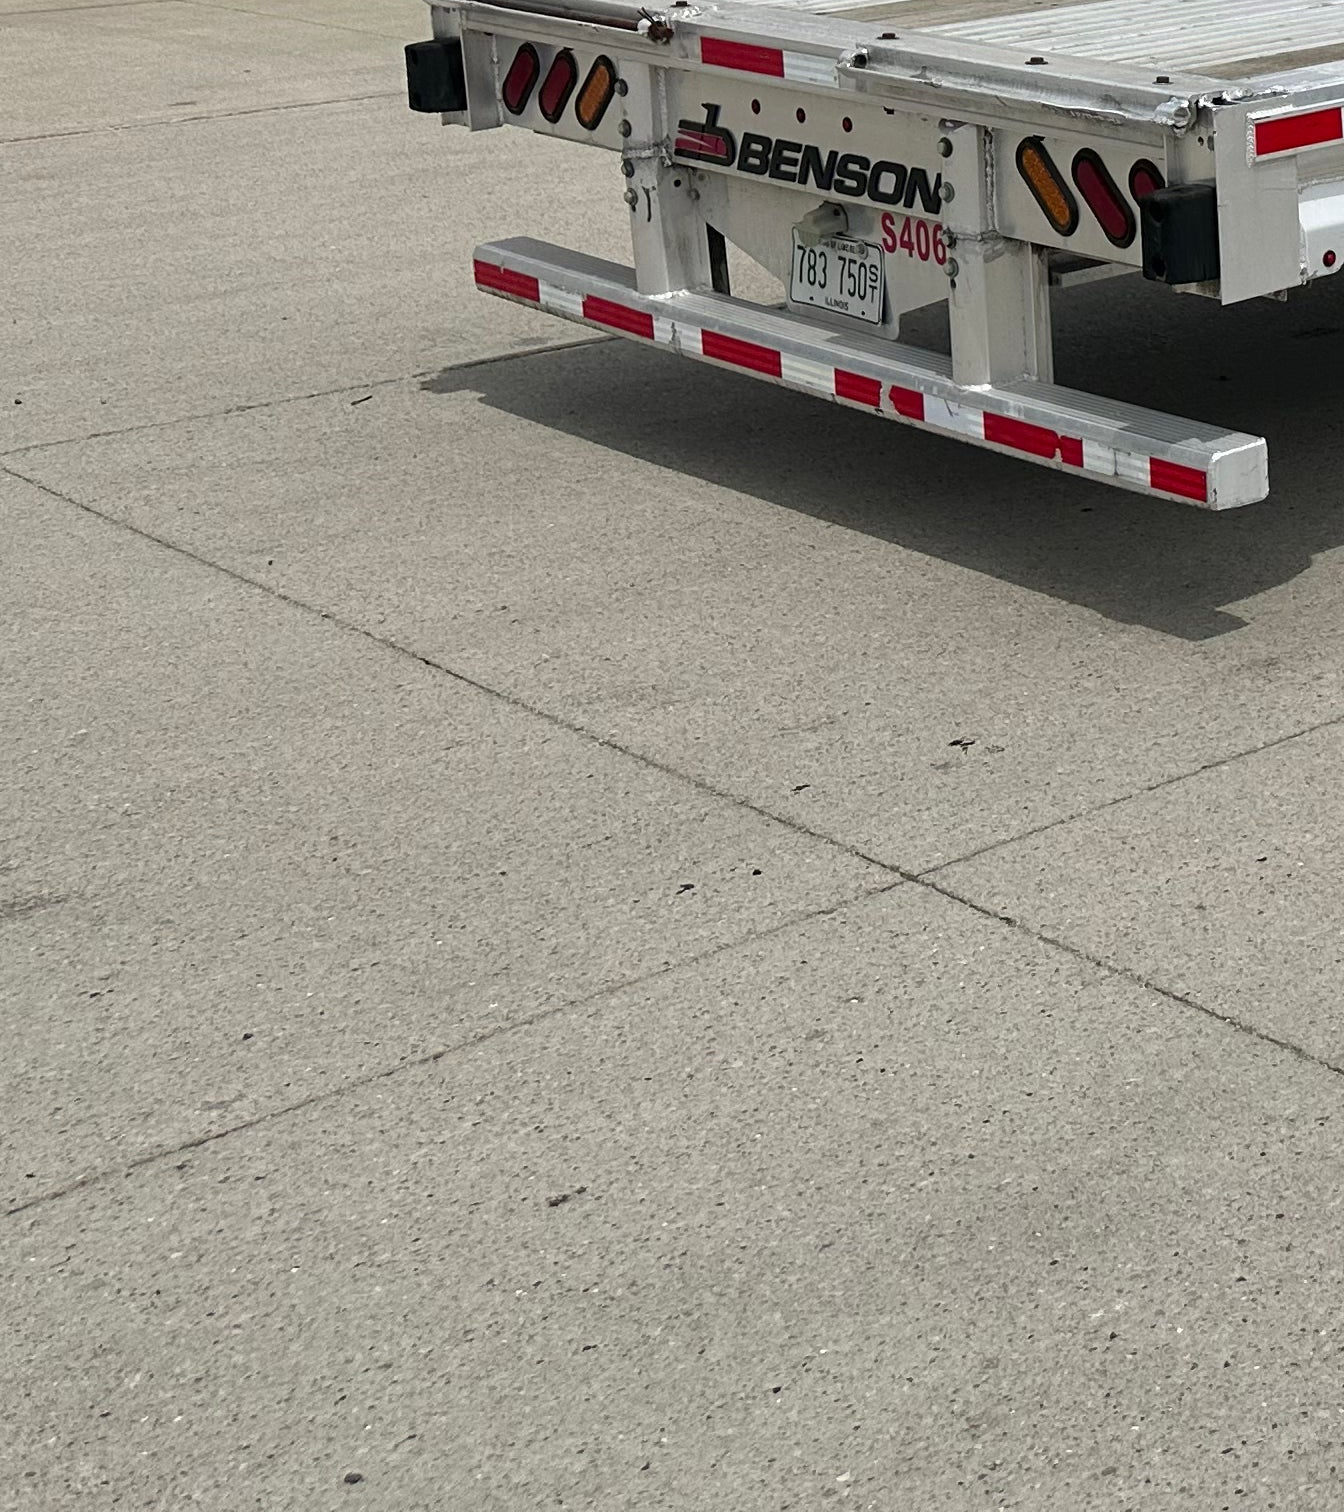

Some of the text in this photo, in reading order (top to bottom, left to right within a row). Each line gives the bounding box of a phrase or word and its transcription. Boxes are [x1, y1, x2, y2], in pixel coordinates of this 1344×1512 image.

[737, 131, 943, 215] BENSON
[881, 212, 947, 266] S406
[797, 245, 868, 301] 783 750
[825, 297, 849, 311] ILLINOIS
